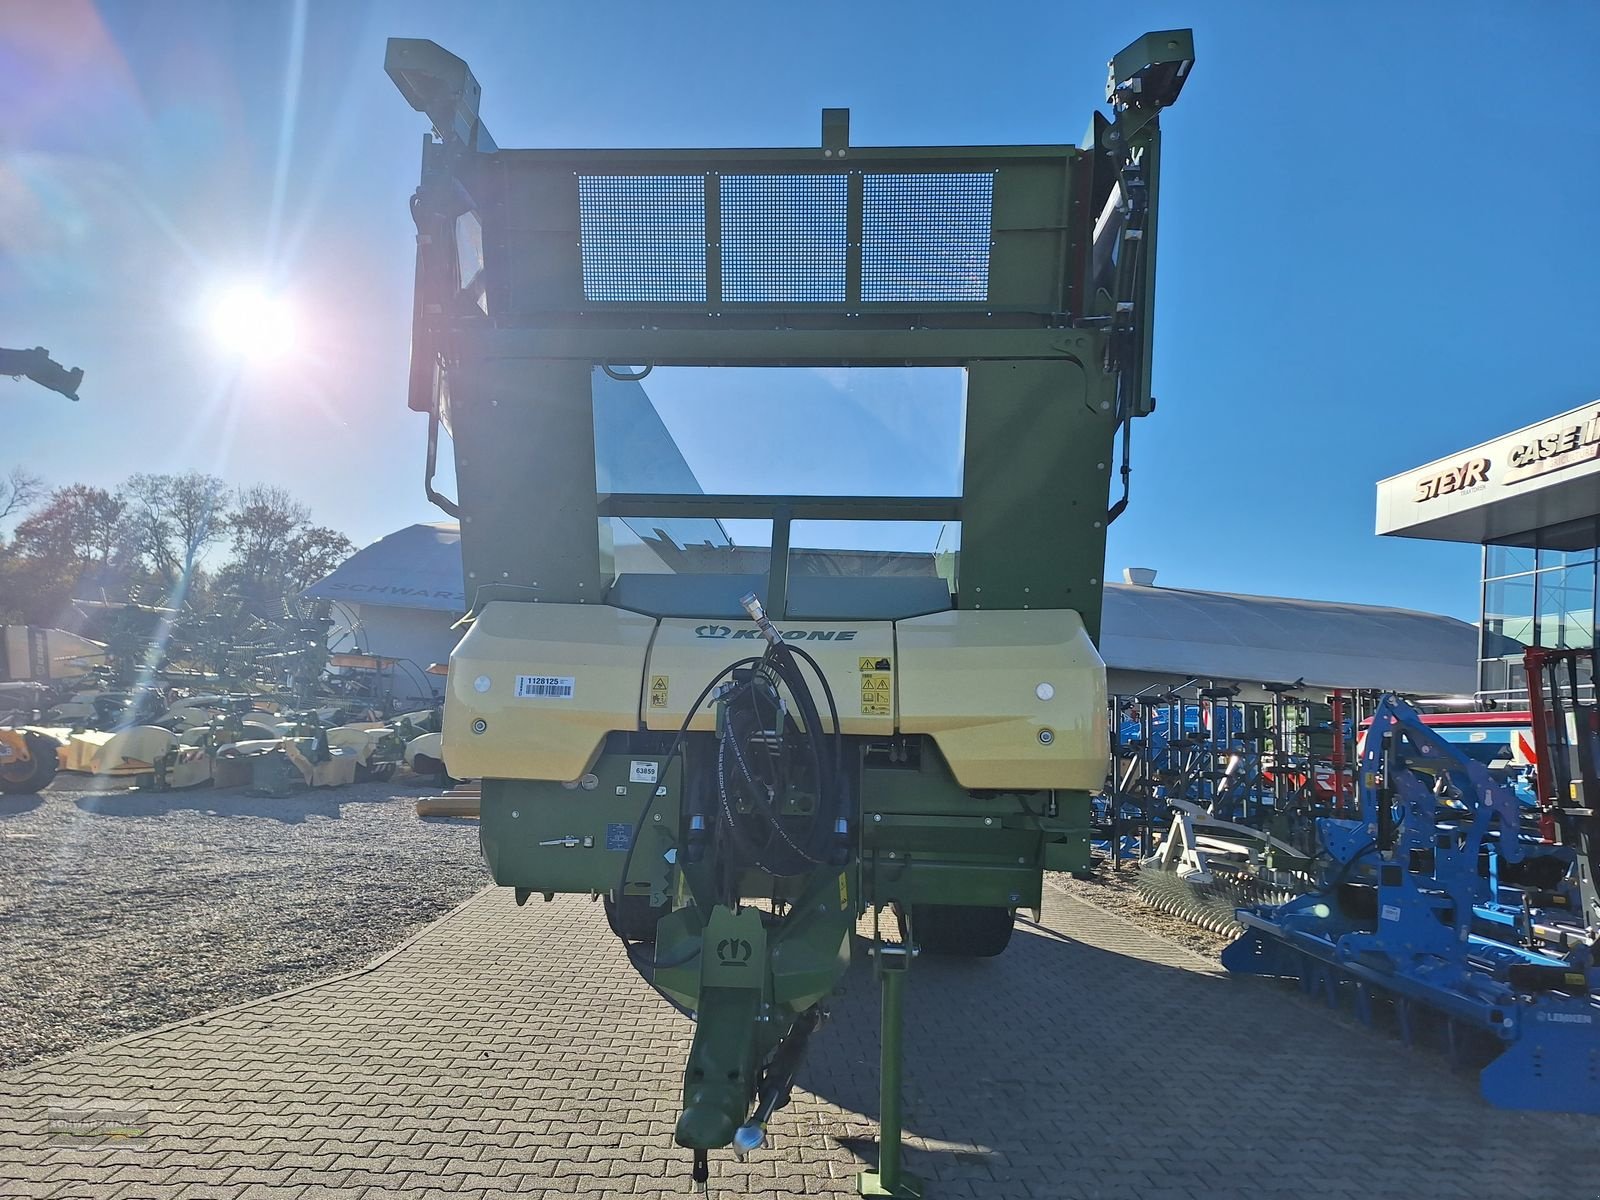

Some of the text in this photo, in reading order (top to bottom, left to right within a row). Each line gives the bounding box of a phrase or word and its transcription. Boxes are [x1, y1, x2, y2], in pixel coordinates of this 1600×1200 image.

[1507, 426, 1580, 468] CASE
[1412, 458, 1491, 502] STEYR
[528, 677, 559, 685] 1128125
